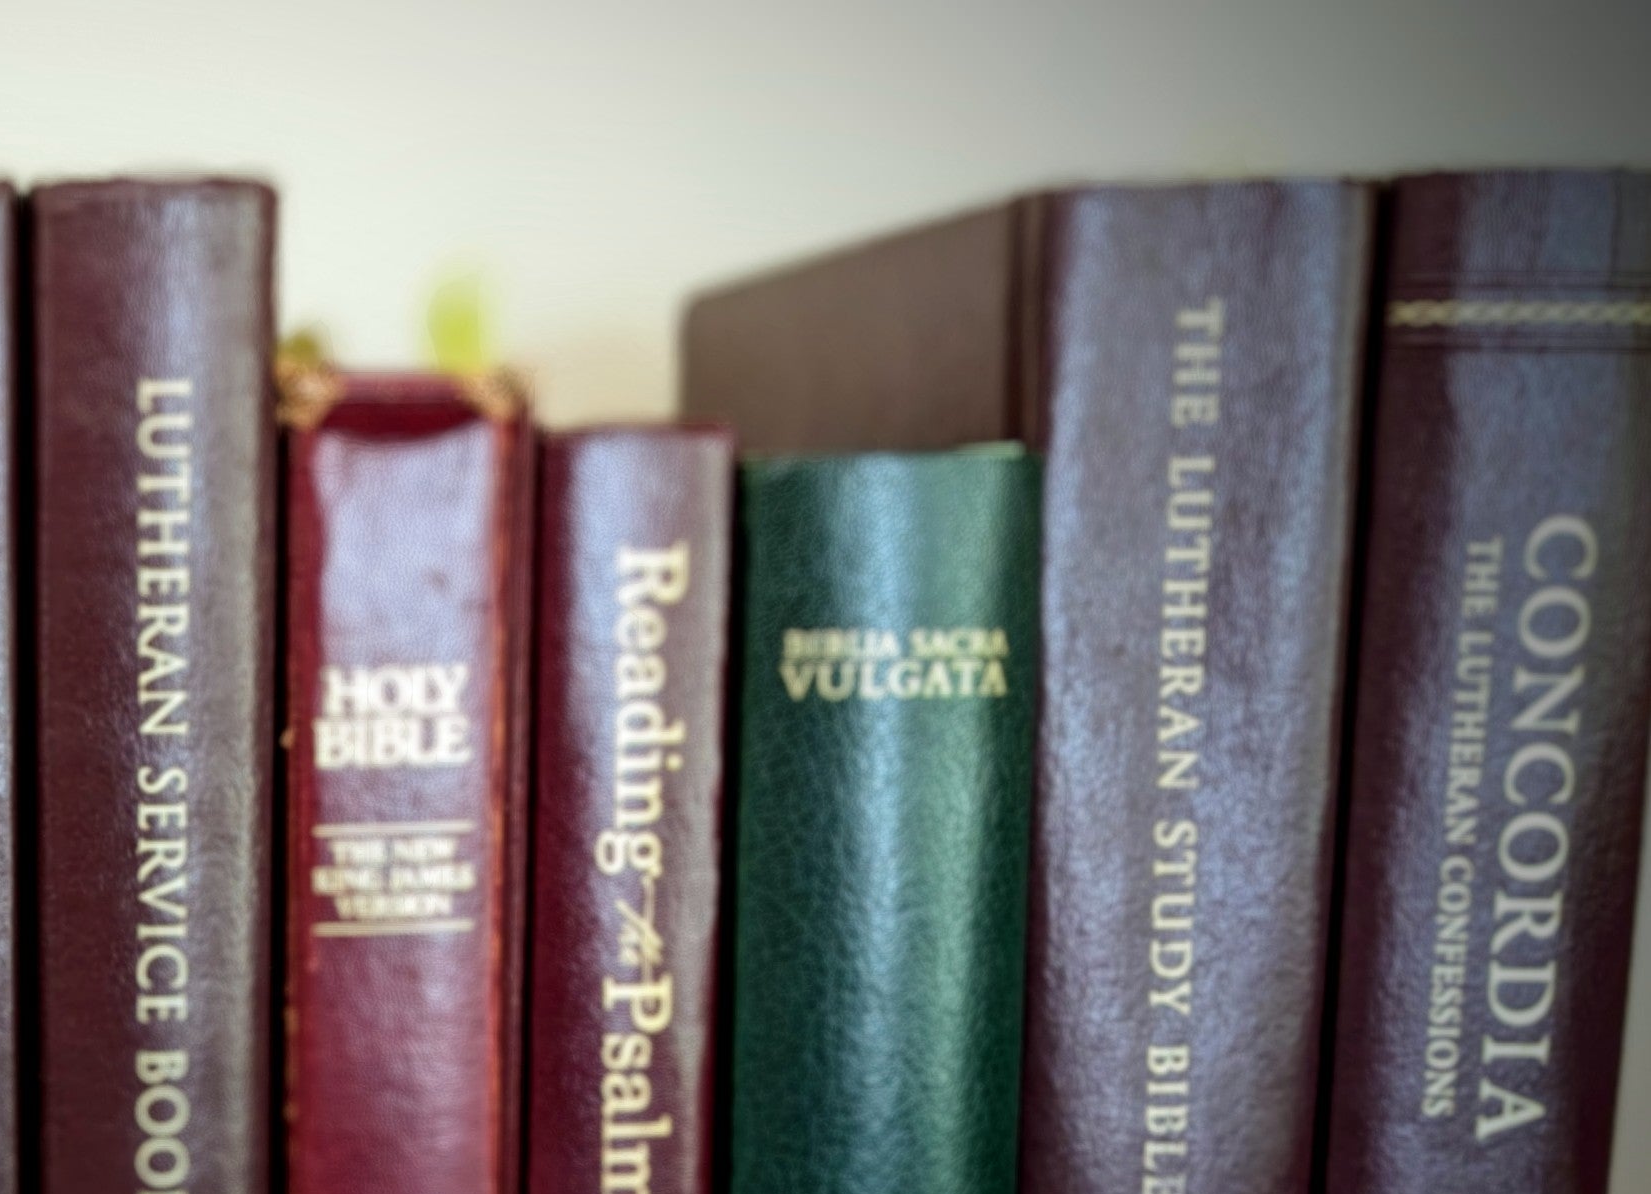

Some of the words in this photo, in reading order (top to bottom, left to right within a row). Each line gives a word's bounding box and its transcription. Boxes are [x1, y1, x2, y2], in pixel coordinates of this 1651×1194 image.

[1170, 296, 1225, 428] THE
[136, 378, 193, 737] LUTHERAN
[783, 627, 899, 659] BIBLIA
[909, 626, 1009, 658] SACRA
[1156, 455, 1217, 790] LUTHERAN
[1462, 533, 1504, 618] THE
[313, 714, 472, 769] BIBLE
[319, 662, 469, 716] HOLY
[595, 540, 691, 879] Reading
[779, 658, 1009, 701] VULGATA
[1445, 630, 1494, 846] LUTHERAN
[135, 766, 189, 1024] SERVICE
[1148, 819, 1198, 1016] STUDY
[1475, 514, 1598, 1141] CONCORDIA
[1421, 856, 1475, 1119] CONFESSIONS
